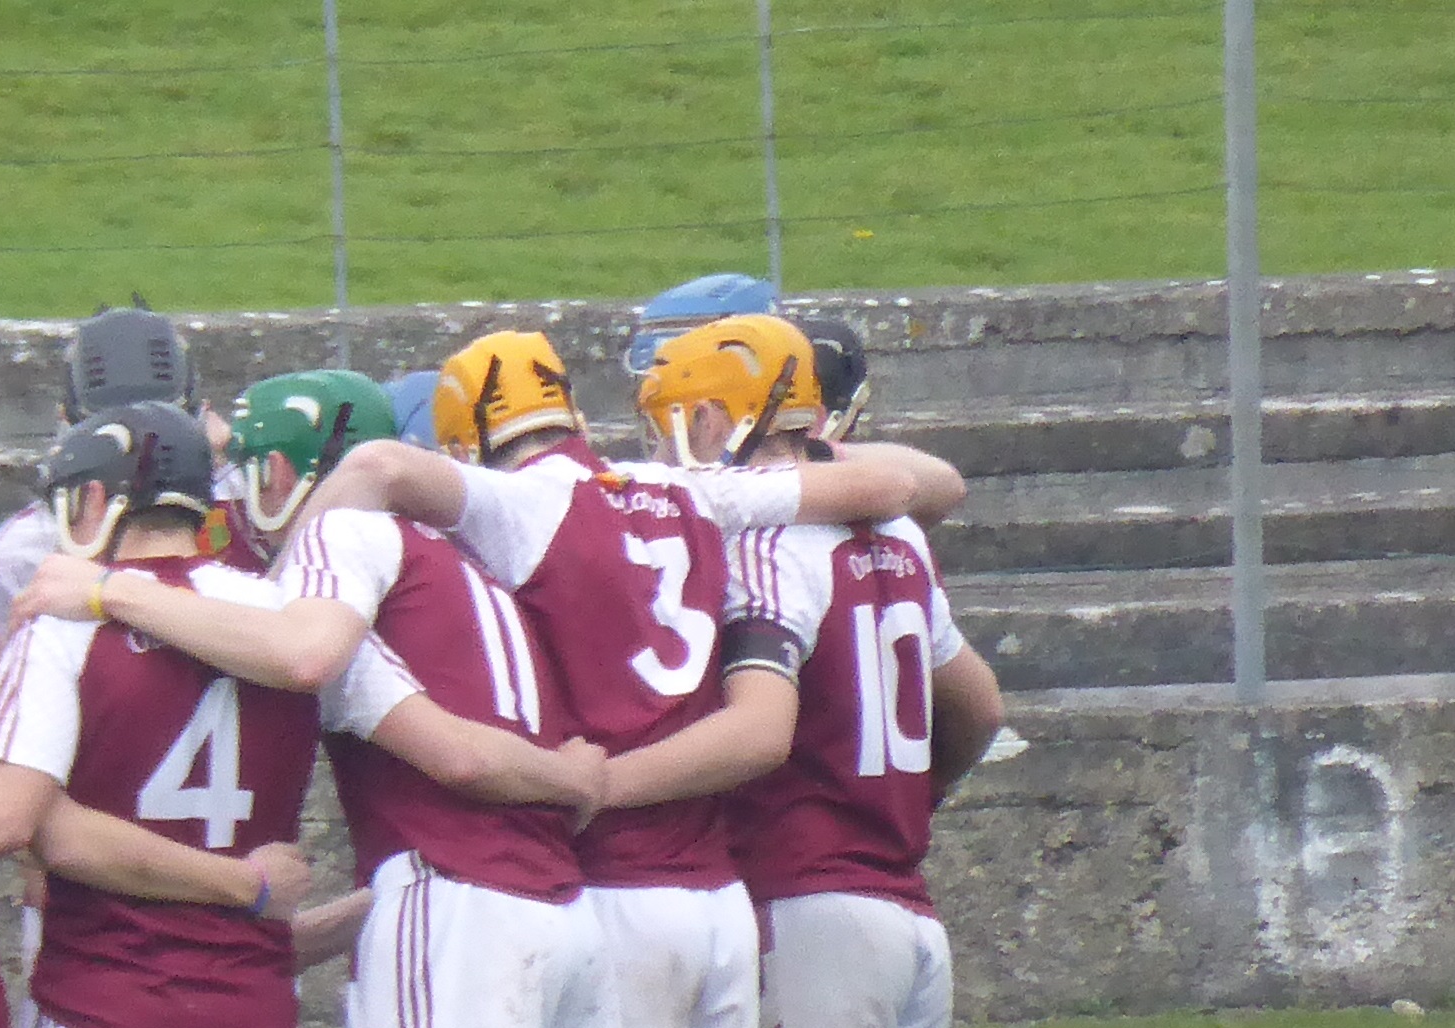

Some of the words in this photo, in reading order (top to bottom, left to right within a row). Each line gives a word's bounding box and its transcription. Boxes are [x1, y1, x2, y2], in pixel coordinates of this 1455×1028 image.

[460, 560, 542, 736] 11
[622, 531, 717, 697] 3
[851, 599, 932, 778] 10
[137, 678, 254, 849] 4
